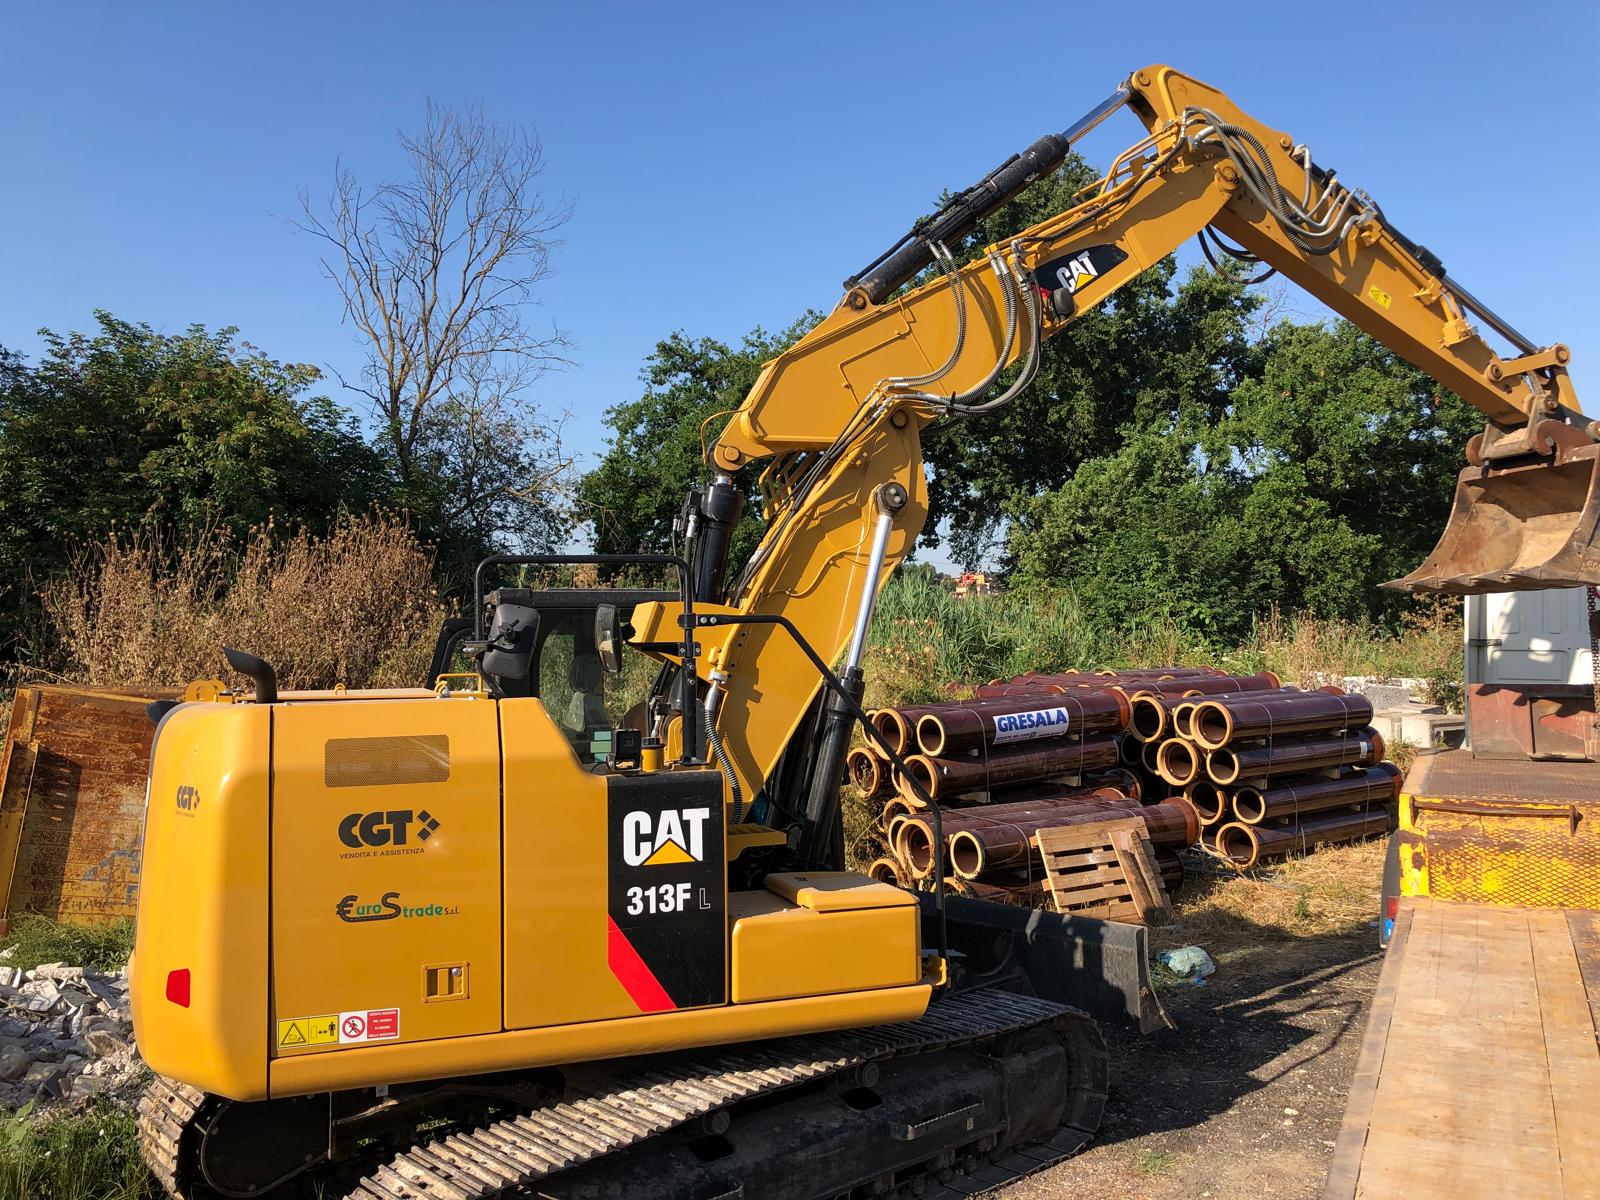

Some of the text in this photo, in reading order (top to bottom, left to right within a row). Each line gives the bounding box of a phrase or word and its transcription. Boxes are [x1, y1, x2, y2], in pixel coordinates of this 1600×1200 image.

[1056, 250, 1098, 293] CAT
[997, 709, 1067, 733] GRESALA
[176, 785, 194, 811] CGT
[338, 809, 413, 848] CGT
[623, 807, 710, 867] CAT
[339, 851, 371, 860] VENDITA
[380, 847, 425, 857] ASSISTENZA
[626, 882, 711, 916] 313F L
